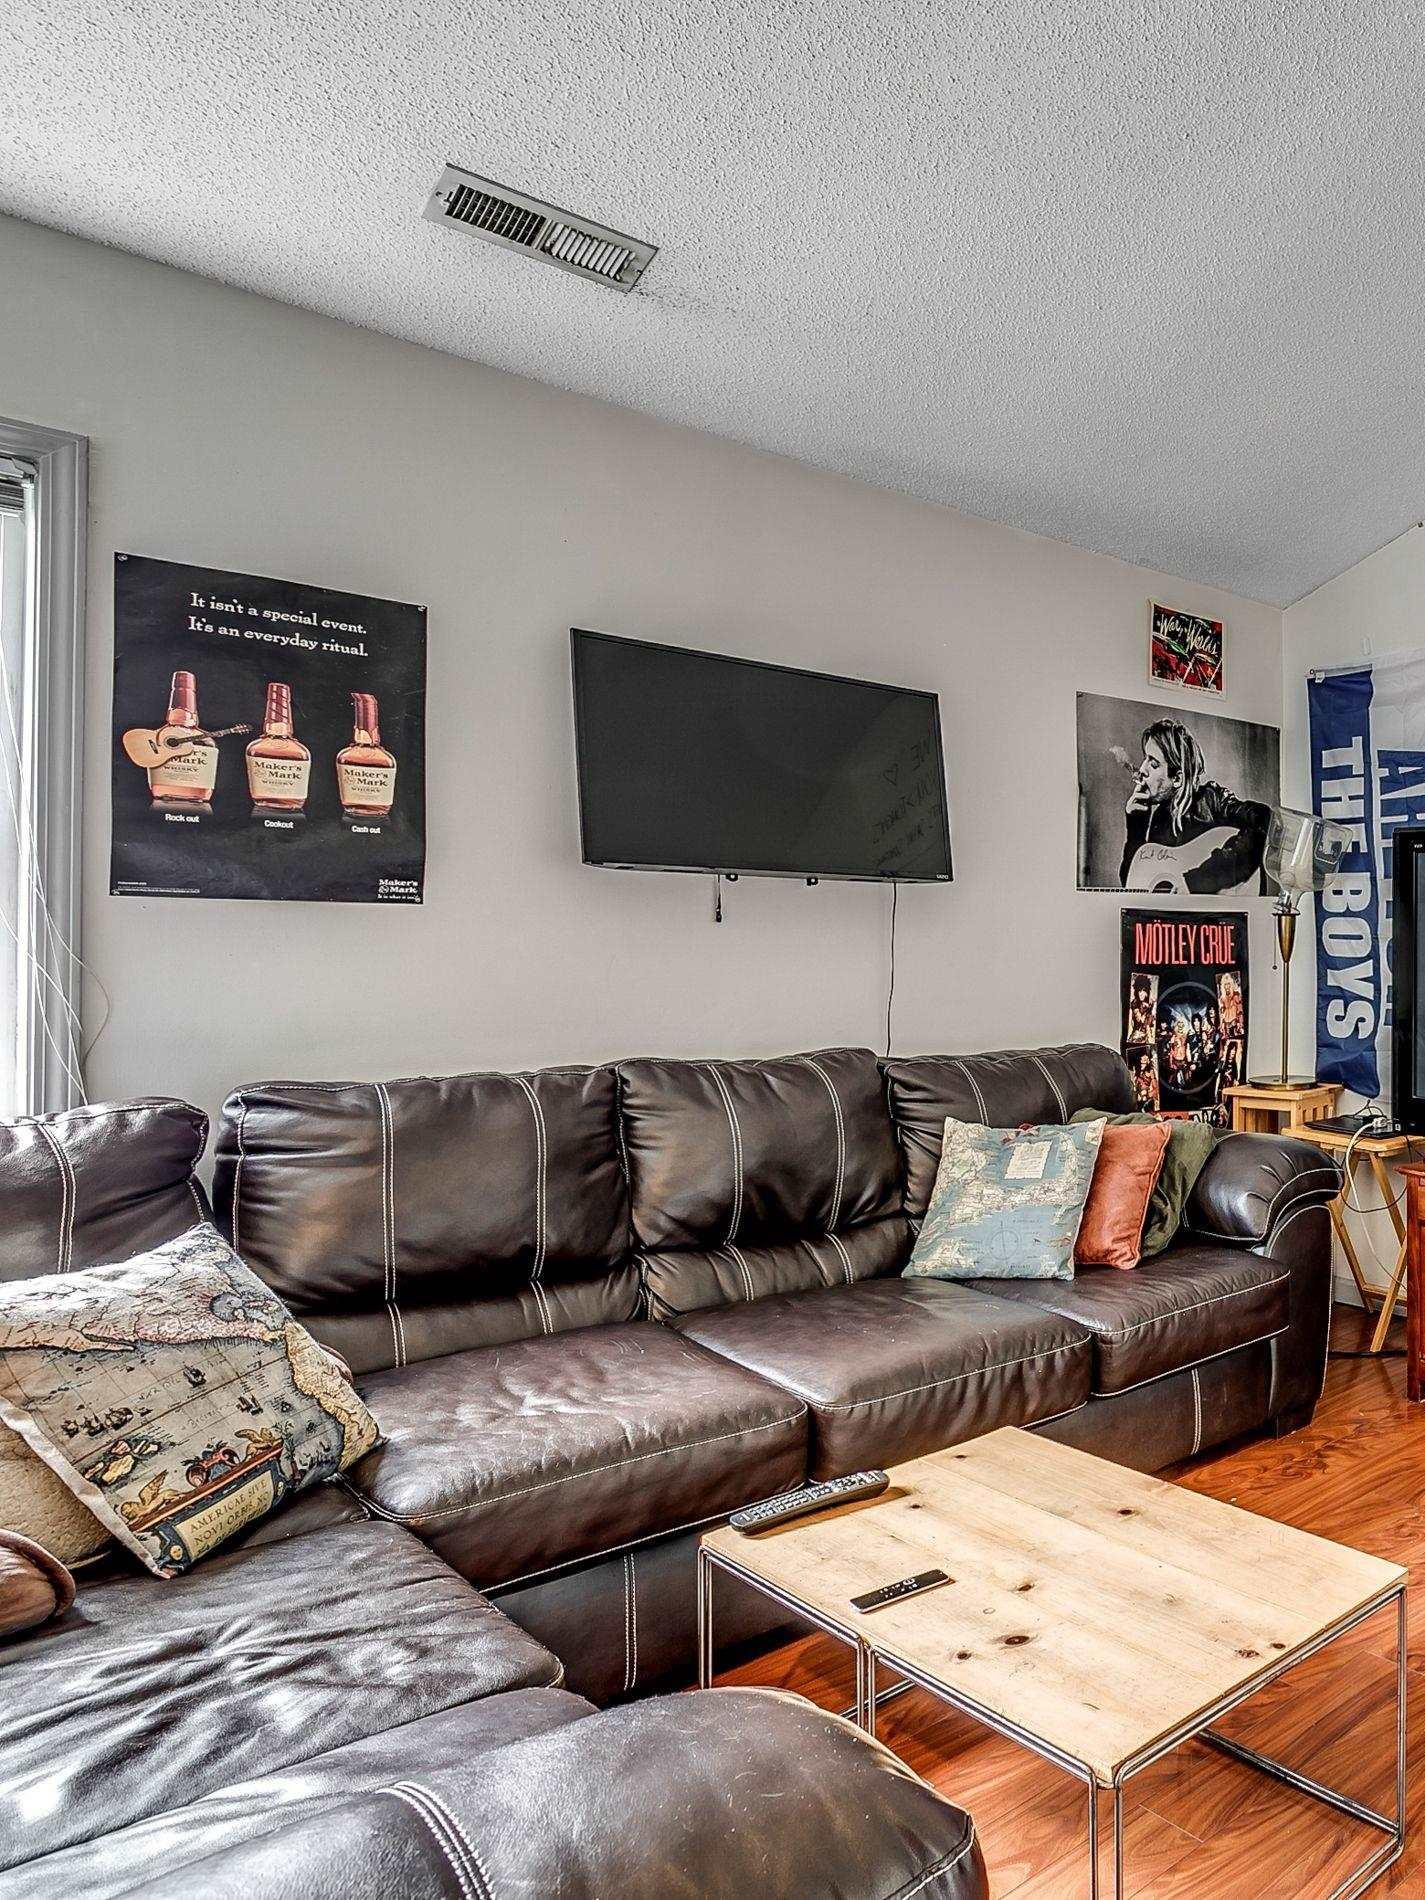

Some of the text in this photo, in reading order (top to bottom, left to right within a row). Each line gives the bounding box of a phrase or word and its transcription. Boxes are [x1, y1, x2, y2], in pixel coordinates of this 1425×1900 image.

[190, 592, 367, 635] It isn't a special event.
[188, 615, 369, 657] It's an everyday ritual.
[254, 761, 302, 772] Maker's
[268, 771, 301, 780] Mark
[344, 768, 389, 779] Maker's
[357, 777, 388, 787] Mark
[165, 813, 200, 823] Rock out
[351, 825, 368, 834] Cash
[1135, 919, 1236, 965] MÖTLEY CRÜE
[1322, 872, 1375, 1040] BOYS
